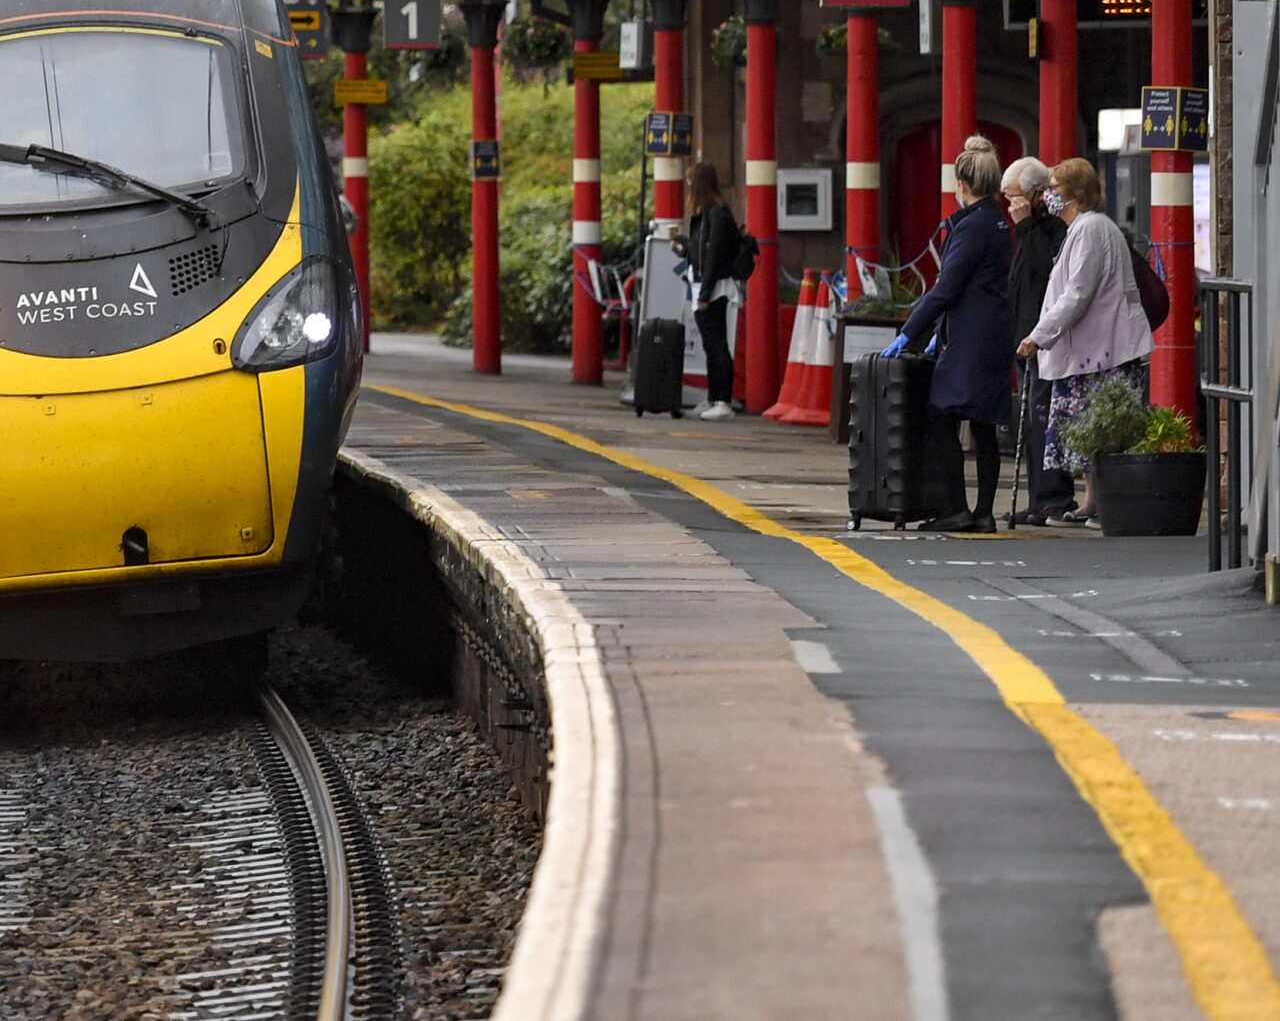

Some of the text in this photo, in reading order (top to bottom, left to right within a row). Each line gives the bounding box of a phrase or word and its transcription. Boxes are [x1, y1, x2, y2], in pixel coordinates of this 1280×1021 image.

[400, 1, 418, 40] 1
[1151, 90, 1169, 98] Protect
[16, 287, 98, 308] AVANTI
[17, 302, 158, 325] WEST COAST
